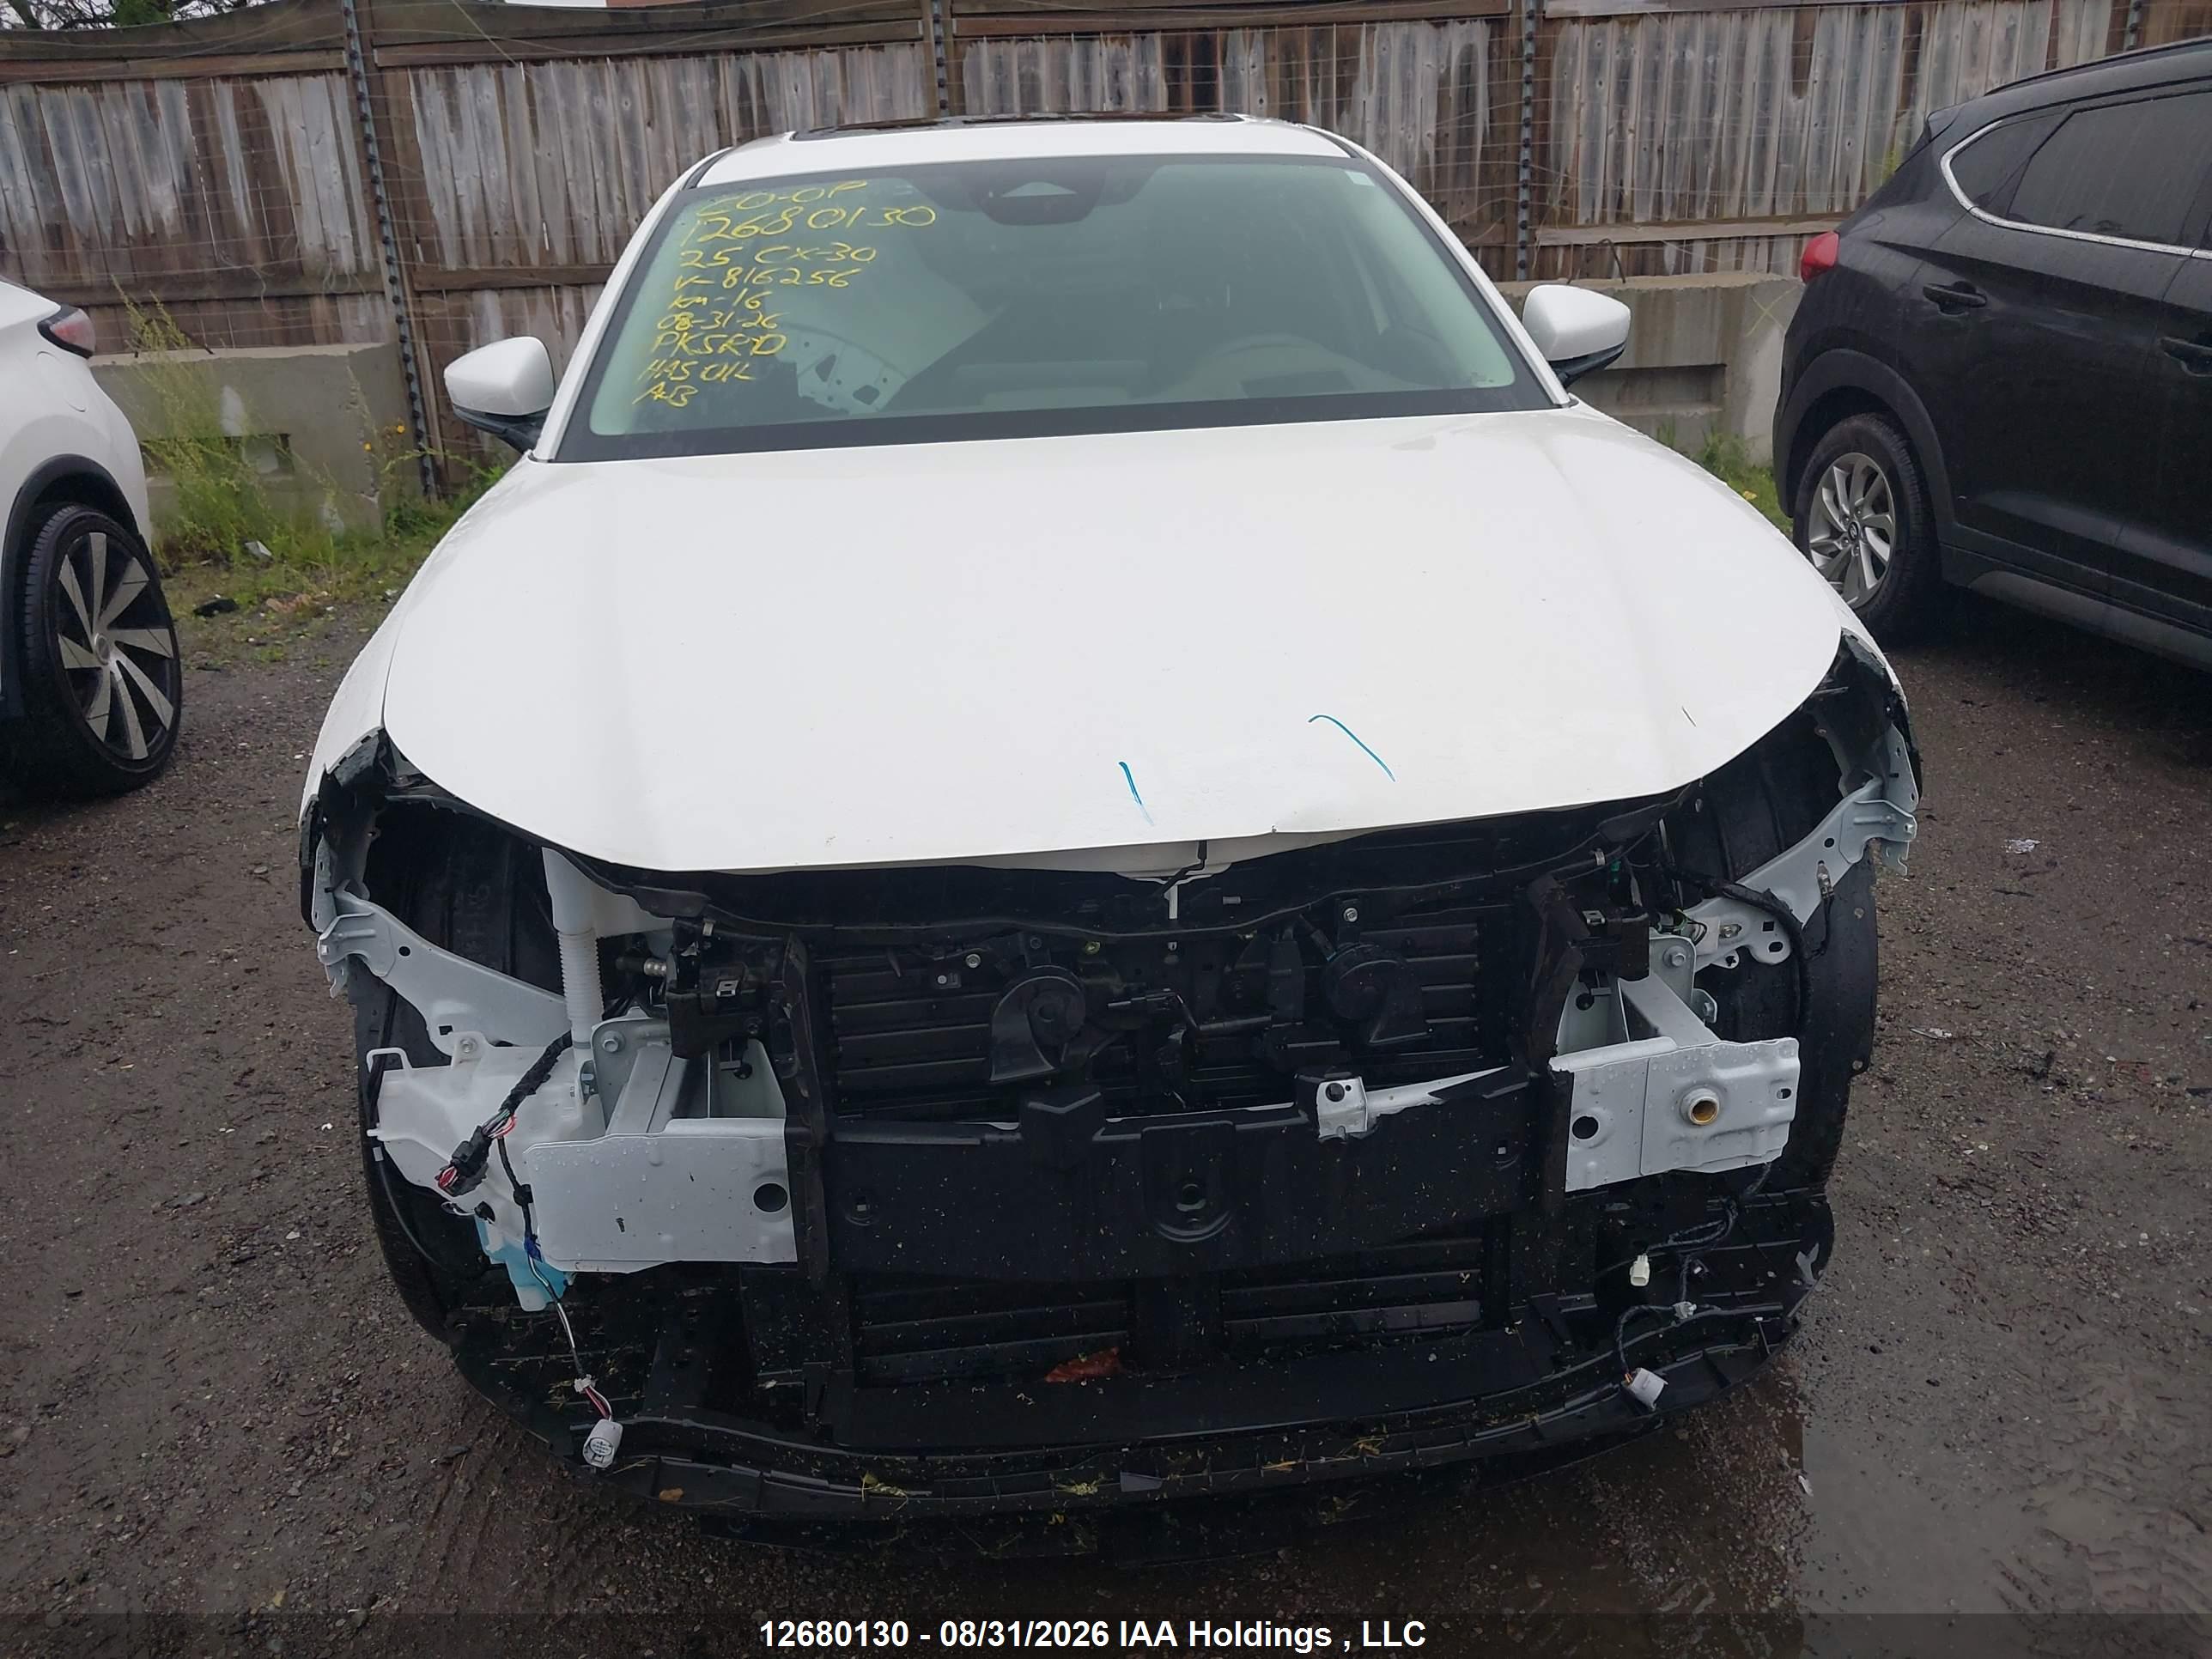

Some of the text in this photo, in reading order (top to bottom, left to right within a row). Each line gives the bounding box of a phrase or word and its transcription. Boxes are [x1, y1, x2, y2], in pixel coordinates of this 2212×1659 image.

[680, 205, 937, 247] 12680130
[679, 242, 877, 269] 25 CX-30
[637, 359, 699, 382] HAS
